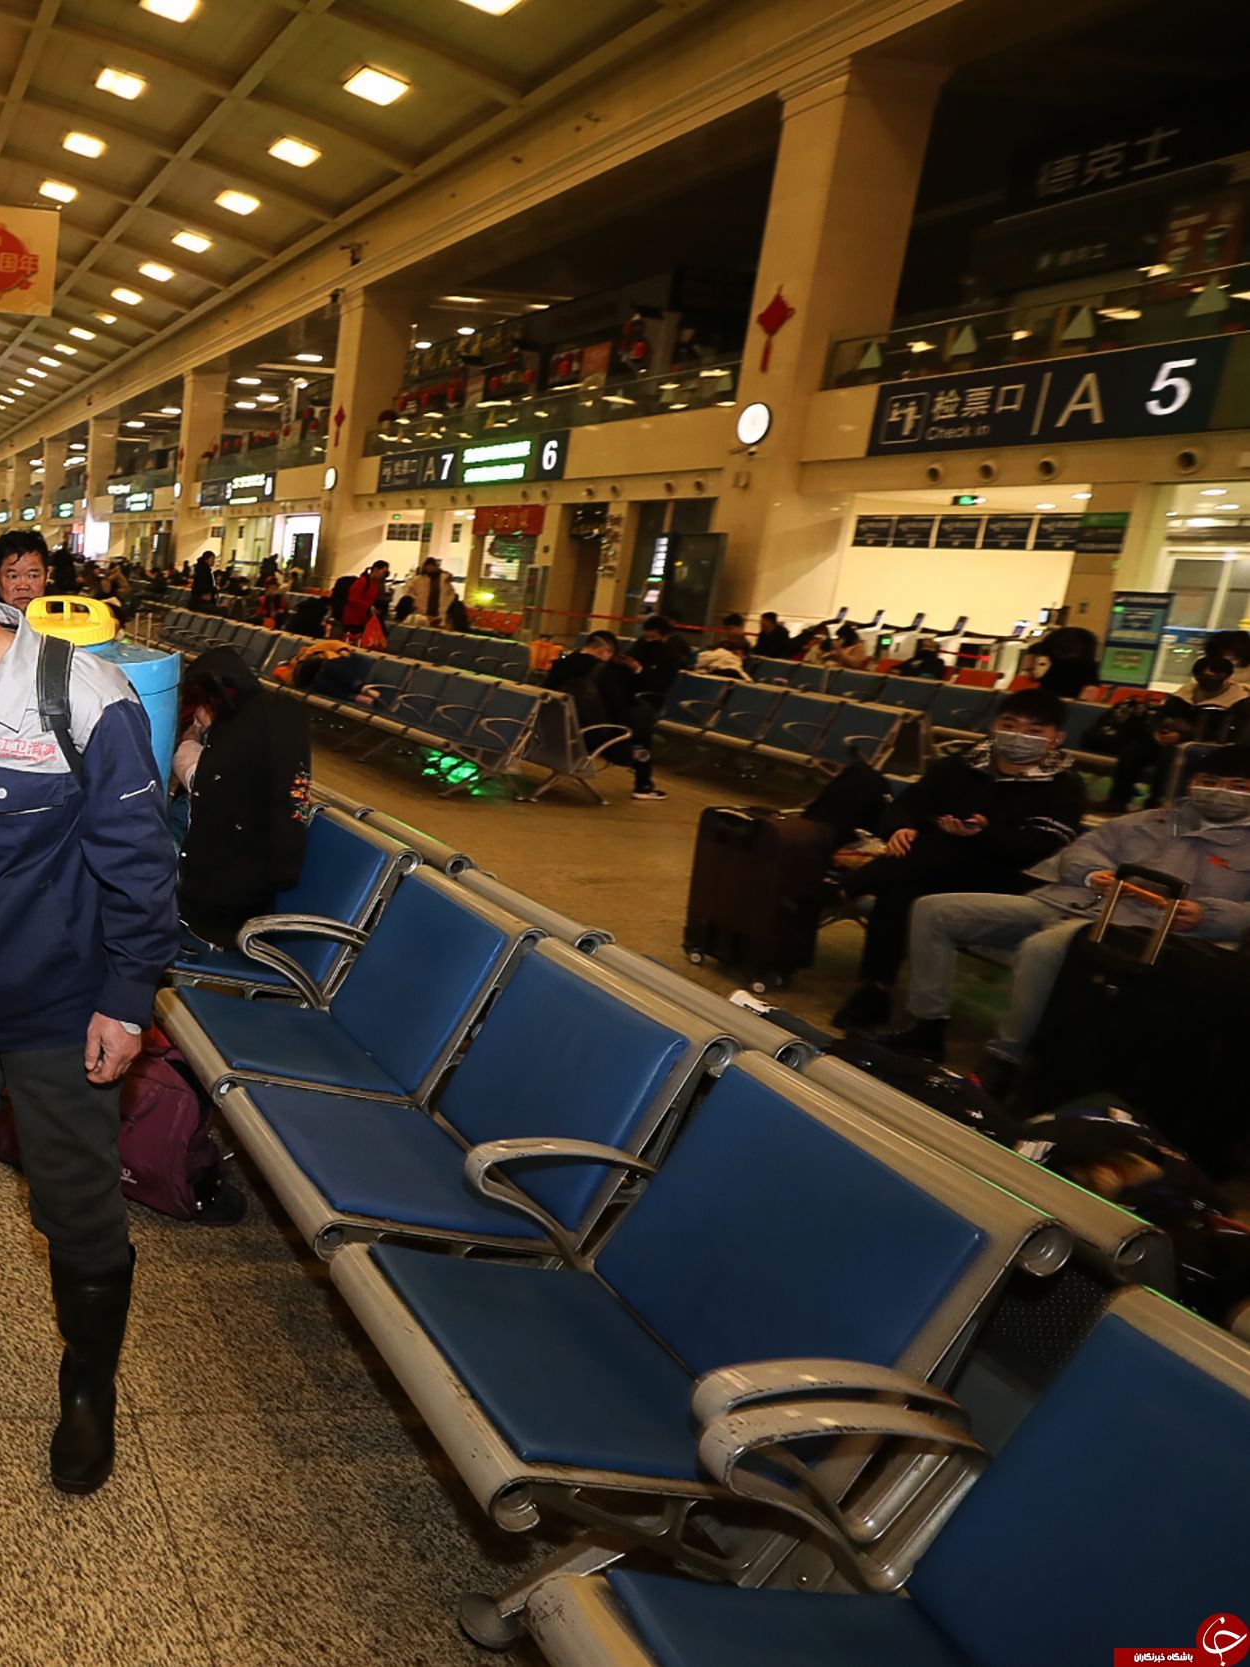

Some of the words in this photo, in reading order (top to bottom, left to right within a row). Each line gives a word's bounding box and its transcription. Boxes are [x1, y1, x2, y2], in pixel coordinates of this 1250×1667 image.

[931, 384, 1027, 422] 检票口
[1054, 372, 1104, 428] A
[1145, 358, 1197, 417] 5
[422, 455, 436, 482] A
[440, 453, 455, 481] 7
[541, 439, 559, 471] 6
